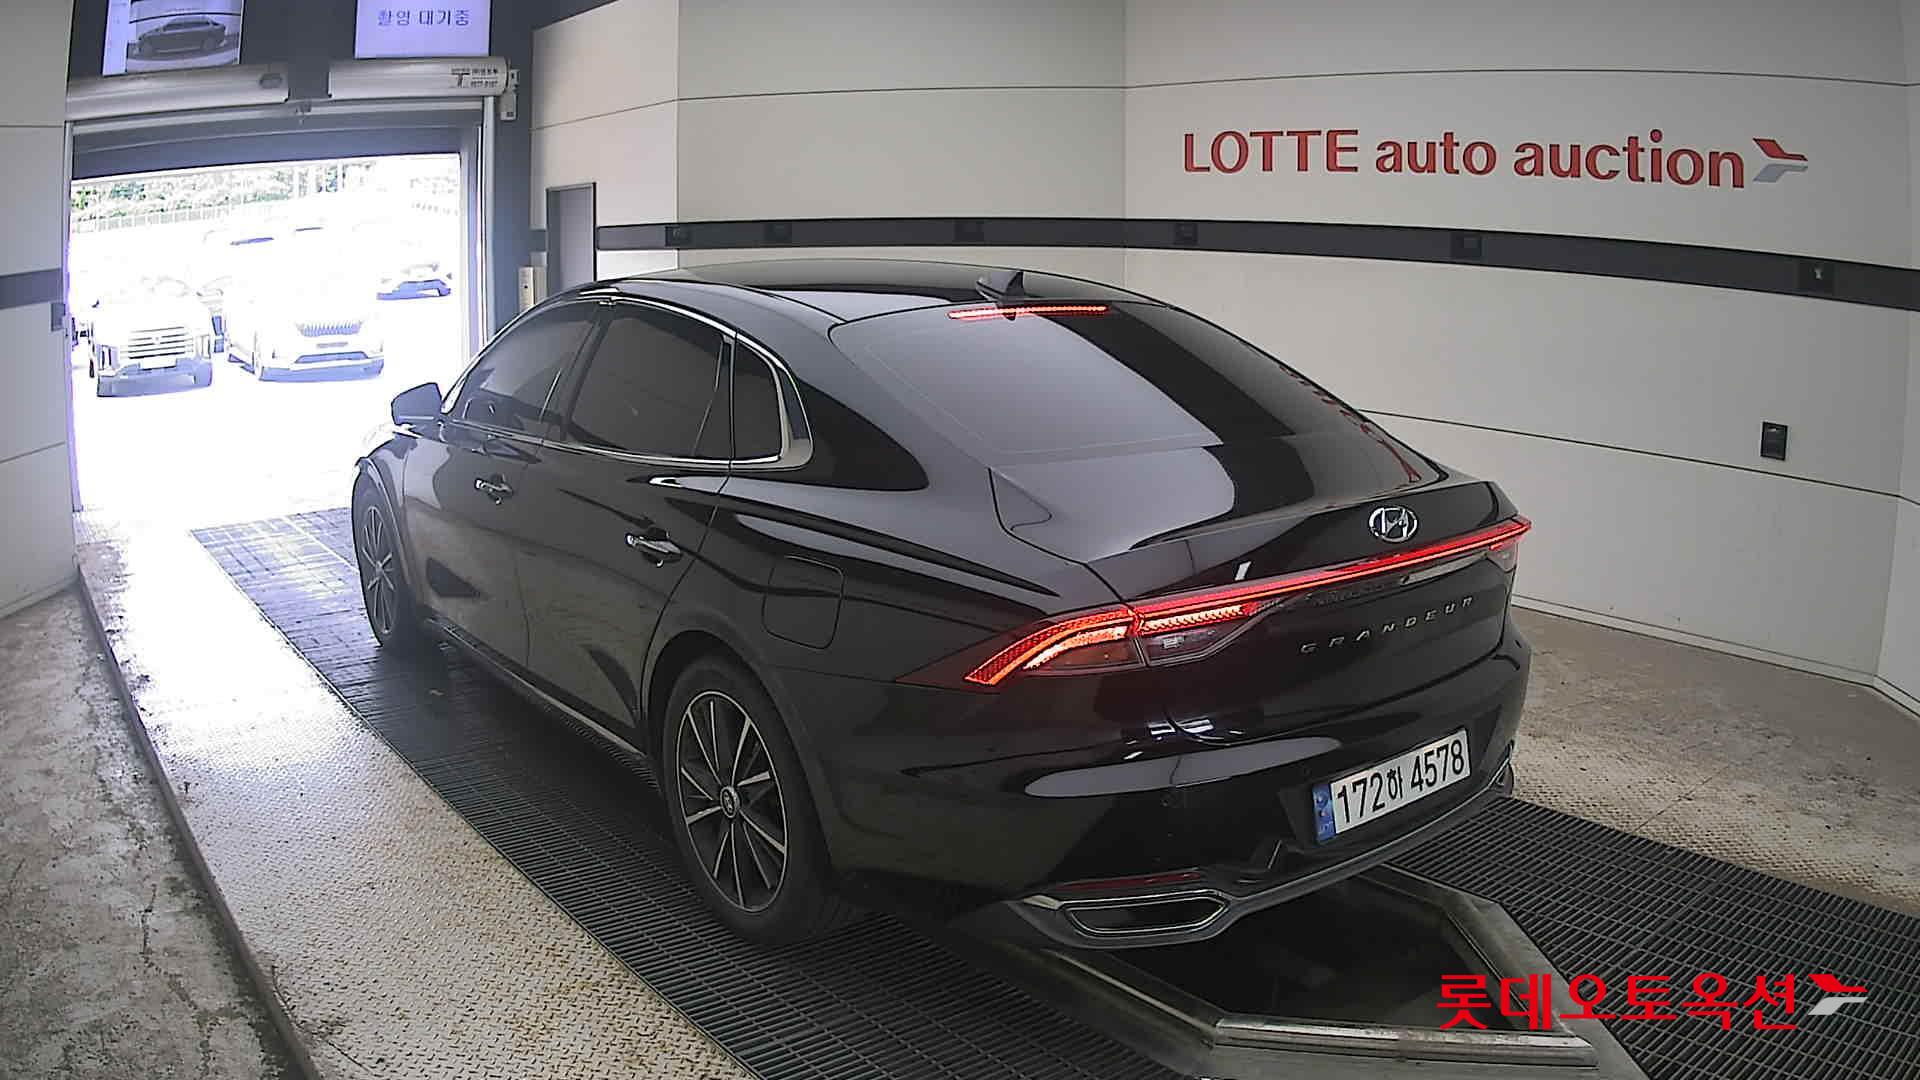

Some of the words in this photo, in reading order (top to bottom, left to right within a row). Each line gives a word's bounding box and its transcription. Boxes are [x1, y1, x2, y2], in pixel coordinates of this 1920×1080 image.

[419, 9, 470, 27] 대기중
[1184, 129, 1360, 174] LOTTE
[1376, 132, 1498, 176] auto
[1513, 129, 1745, 188] auction
[1299, 596, 1474, 655] GRANDEUR
[1336, 765, 1404, 825] 172하
[1410, 739, 1466, 793] 4578
